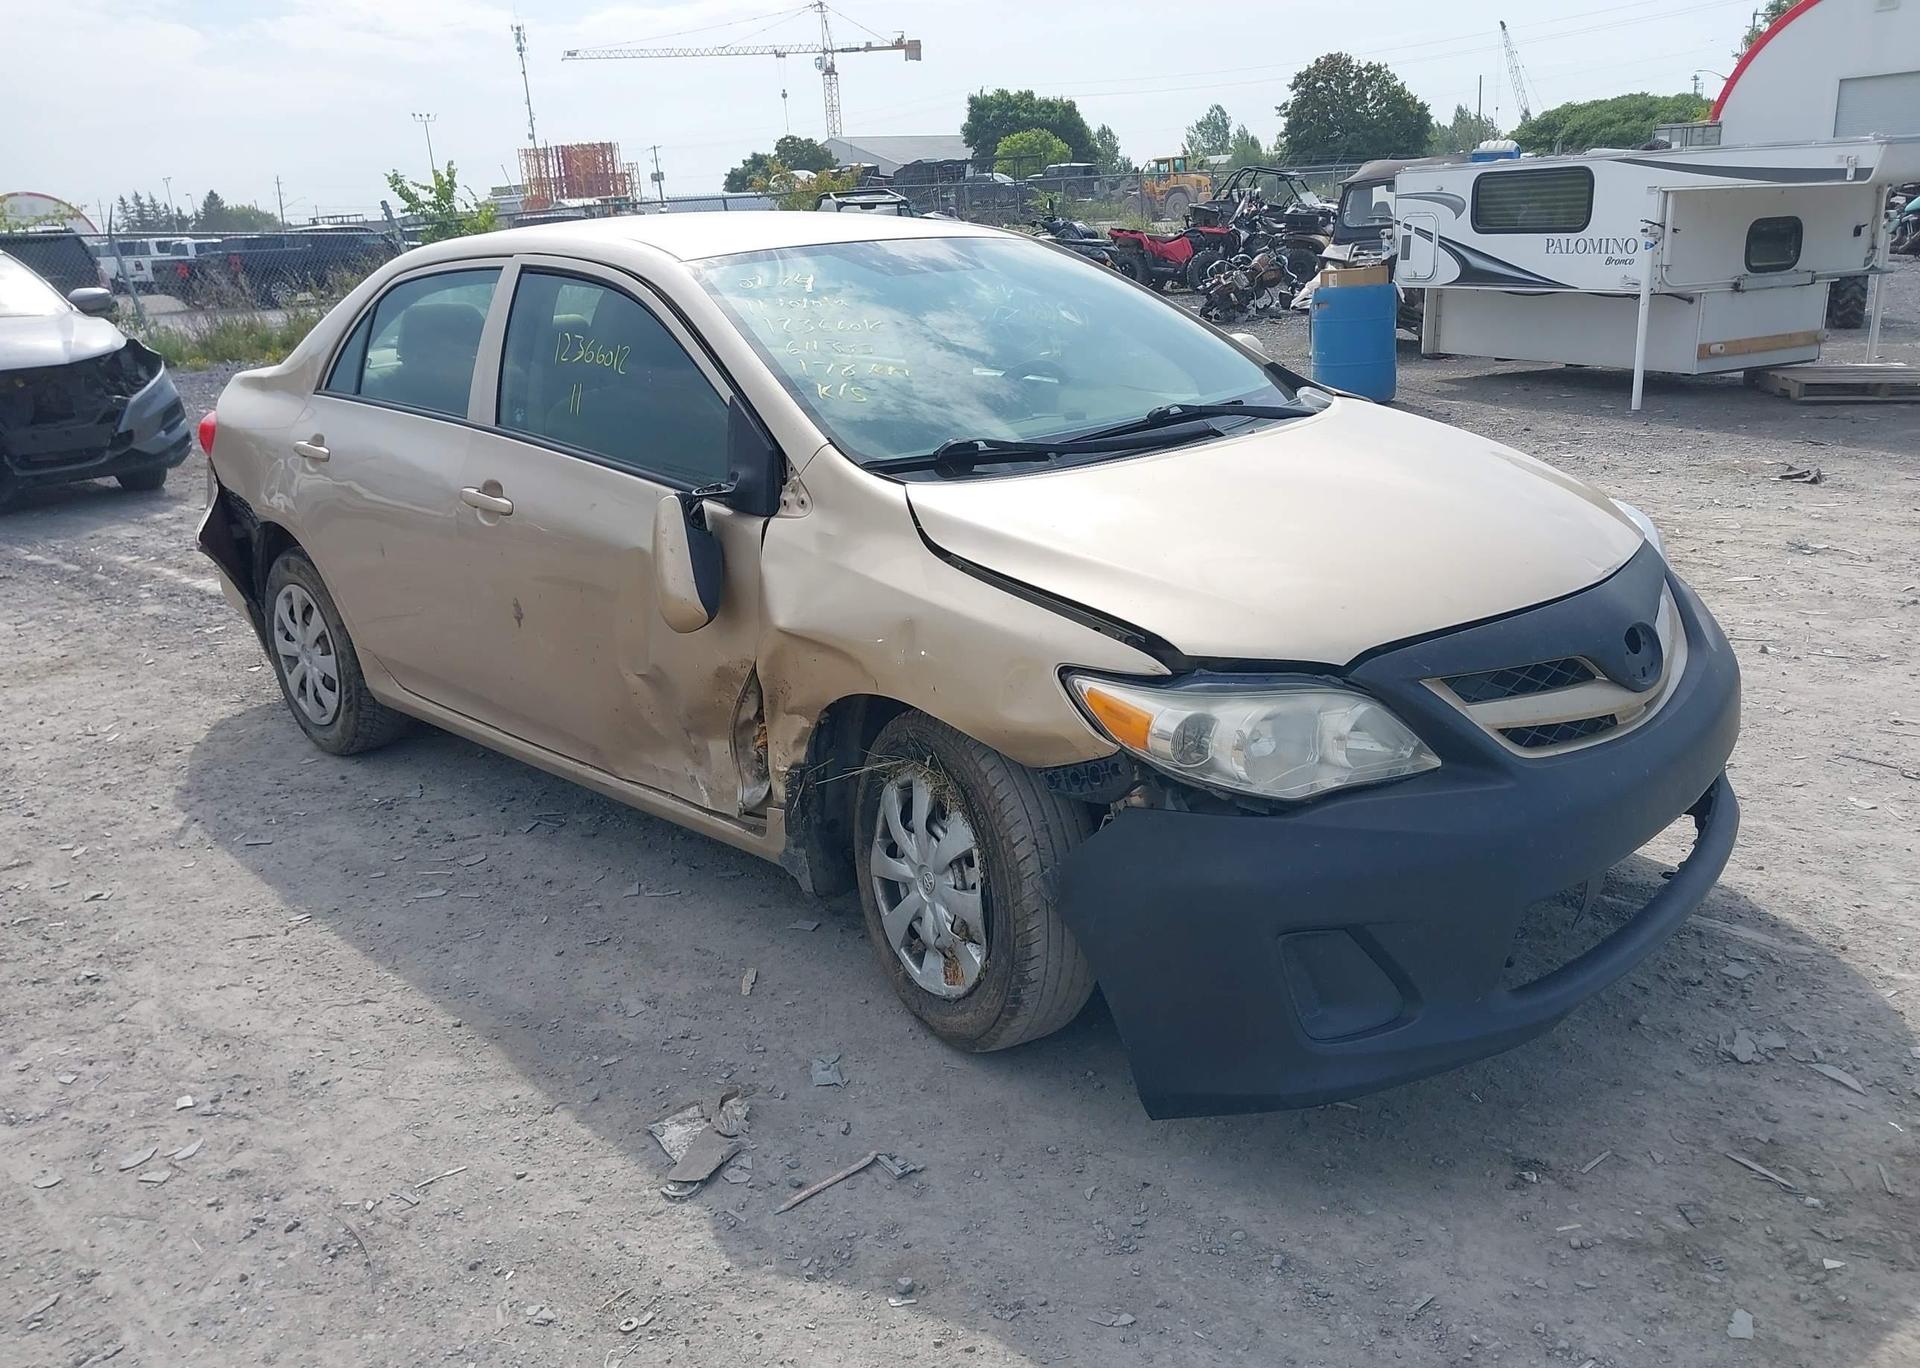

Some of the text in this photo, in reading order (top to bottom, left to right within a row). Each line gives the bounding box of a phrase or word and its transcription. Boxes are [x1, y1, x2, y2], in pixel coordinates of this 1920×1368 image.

[1545, 238, 1638, 254] PALOMINO
[1605, 256, 1635, 265] Bronco
[555, 332, 631, 375] 12366012
